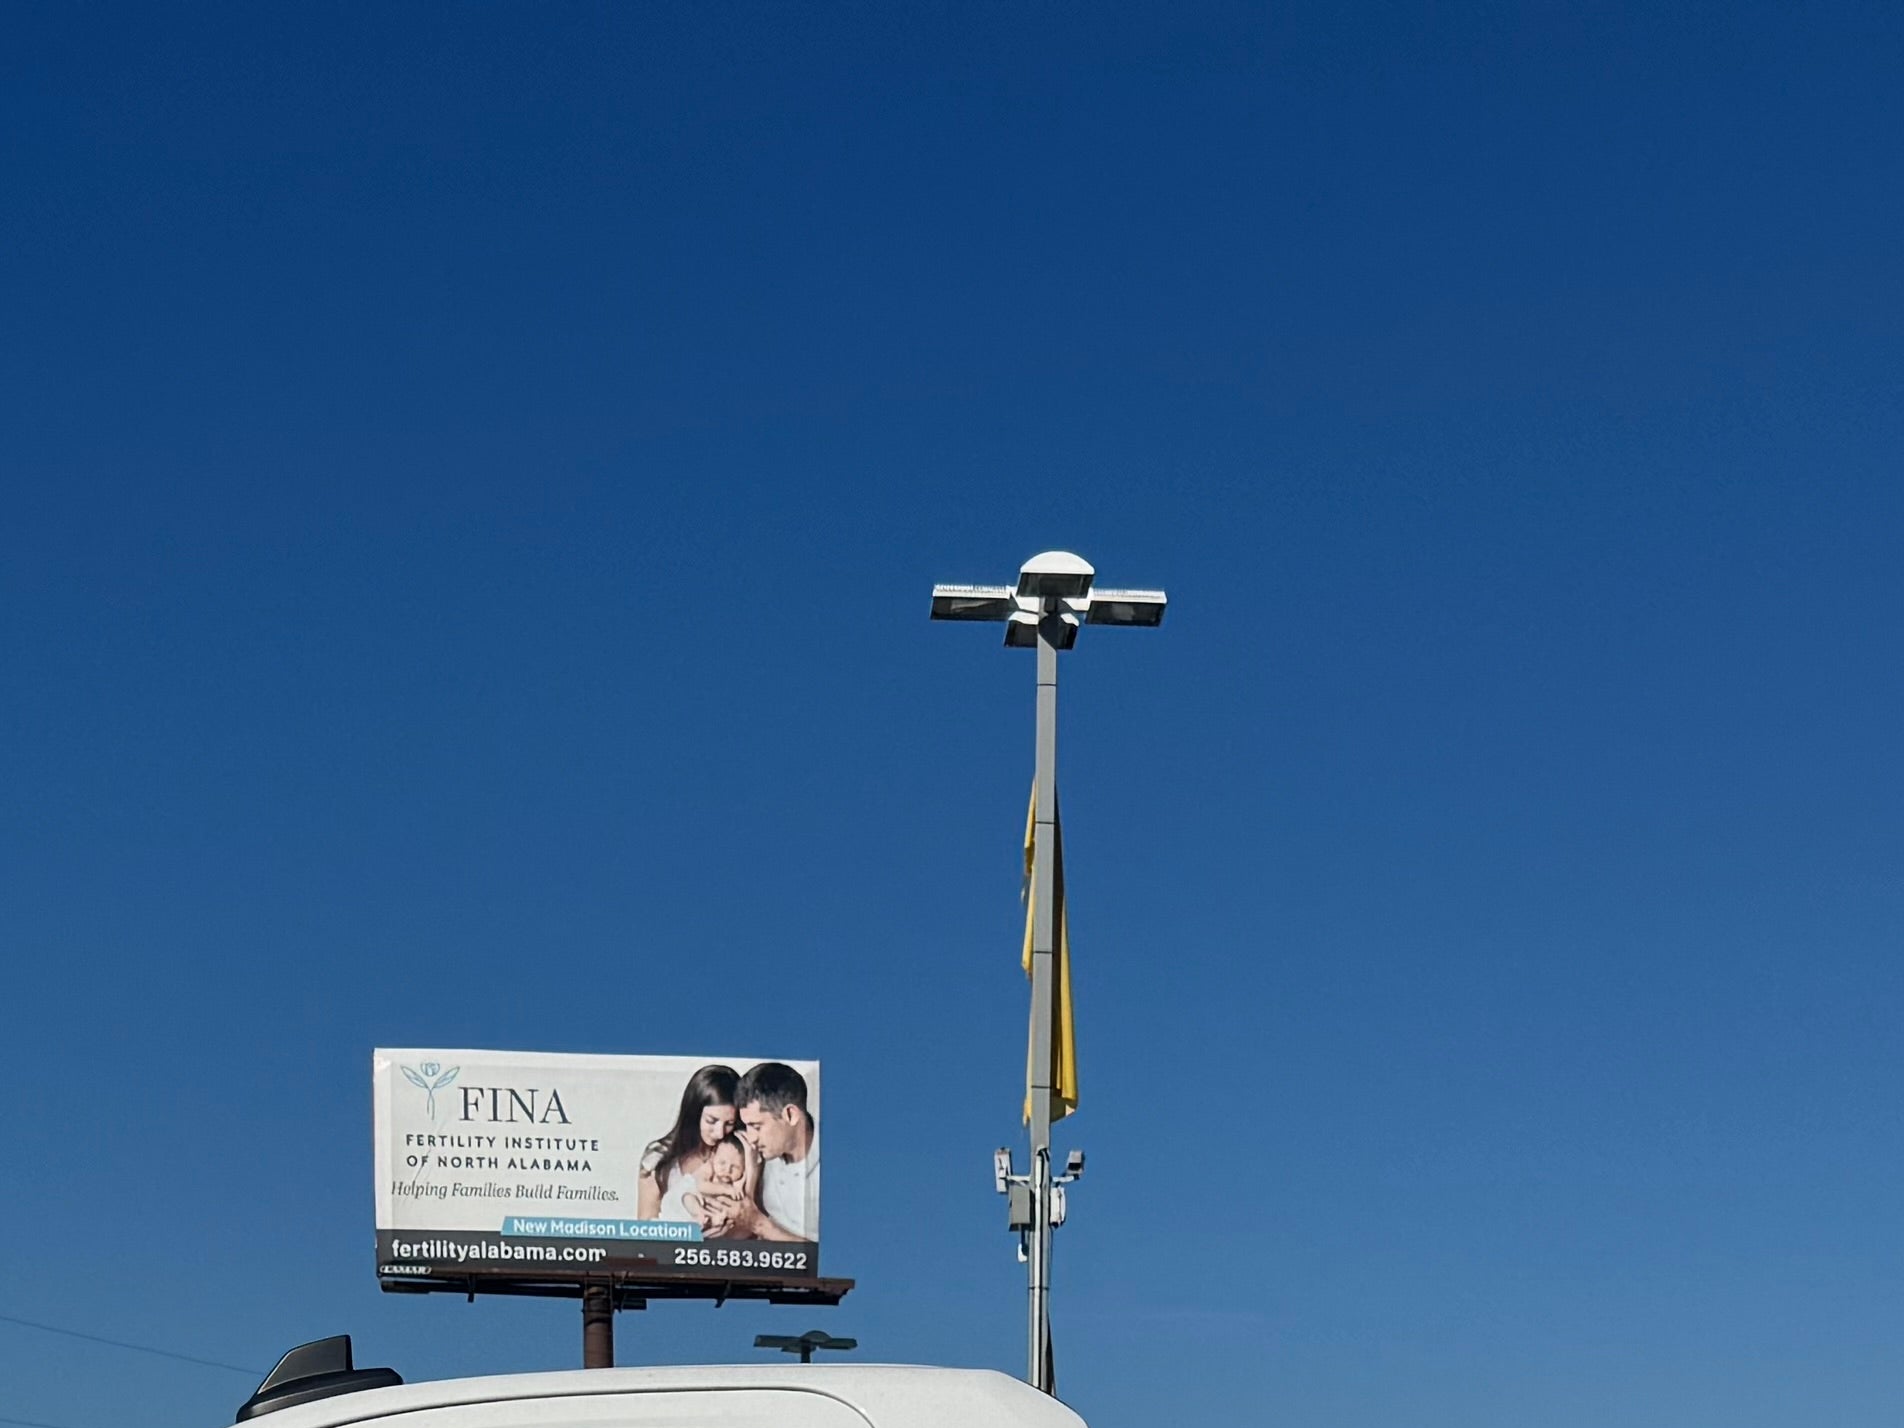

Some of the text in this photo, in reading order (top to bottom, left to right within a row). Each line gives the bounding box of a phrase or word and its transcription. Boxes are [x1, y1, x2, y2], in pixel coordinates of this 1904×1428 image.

[458, 1086, 572, 1124] FINA
[405, 1134, 599, 1152] FERTILITY INSTITUTE
[406, 1155, 592, 1171] OF NORTH ALABAMA
[391, 1180, 619, 1201] Helping Families Build Families.
[513, 1219, 693, 1240] New Madison Location!
[674, 1247, 808, 1270] 256.583.9622
